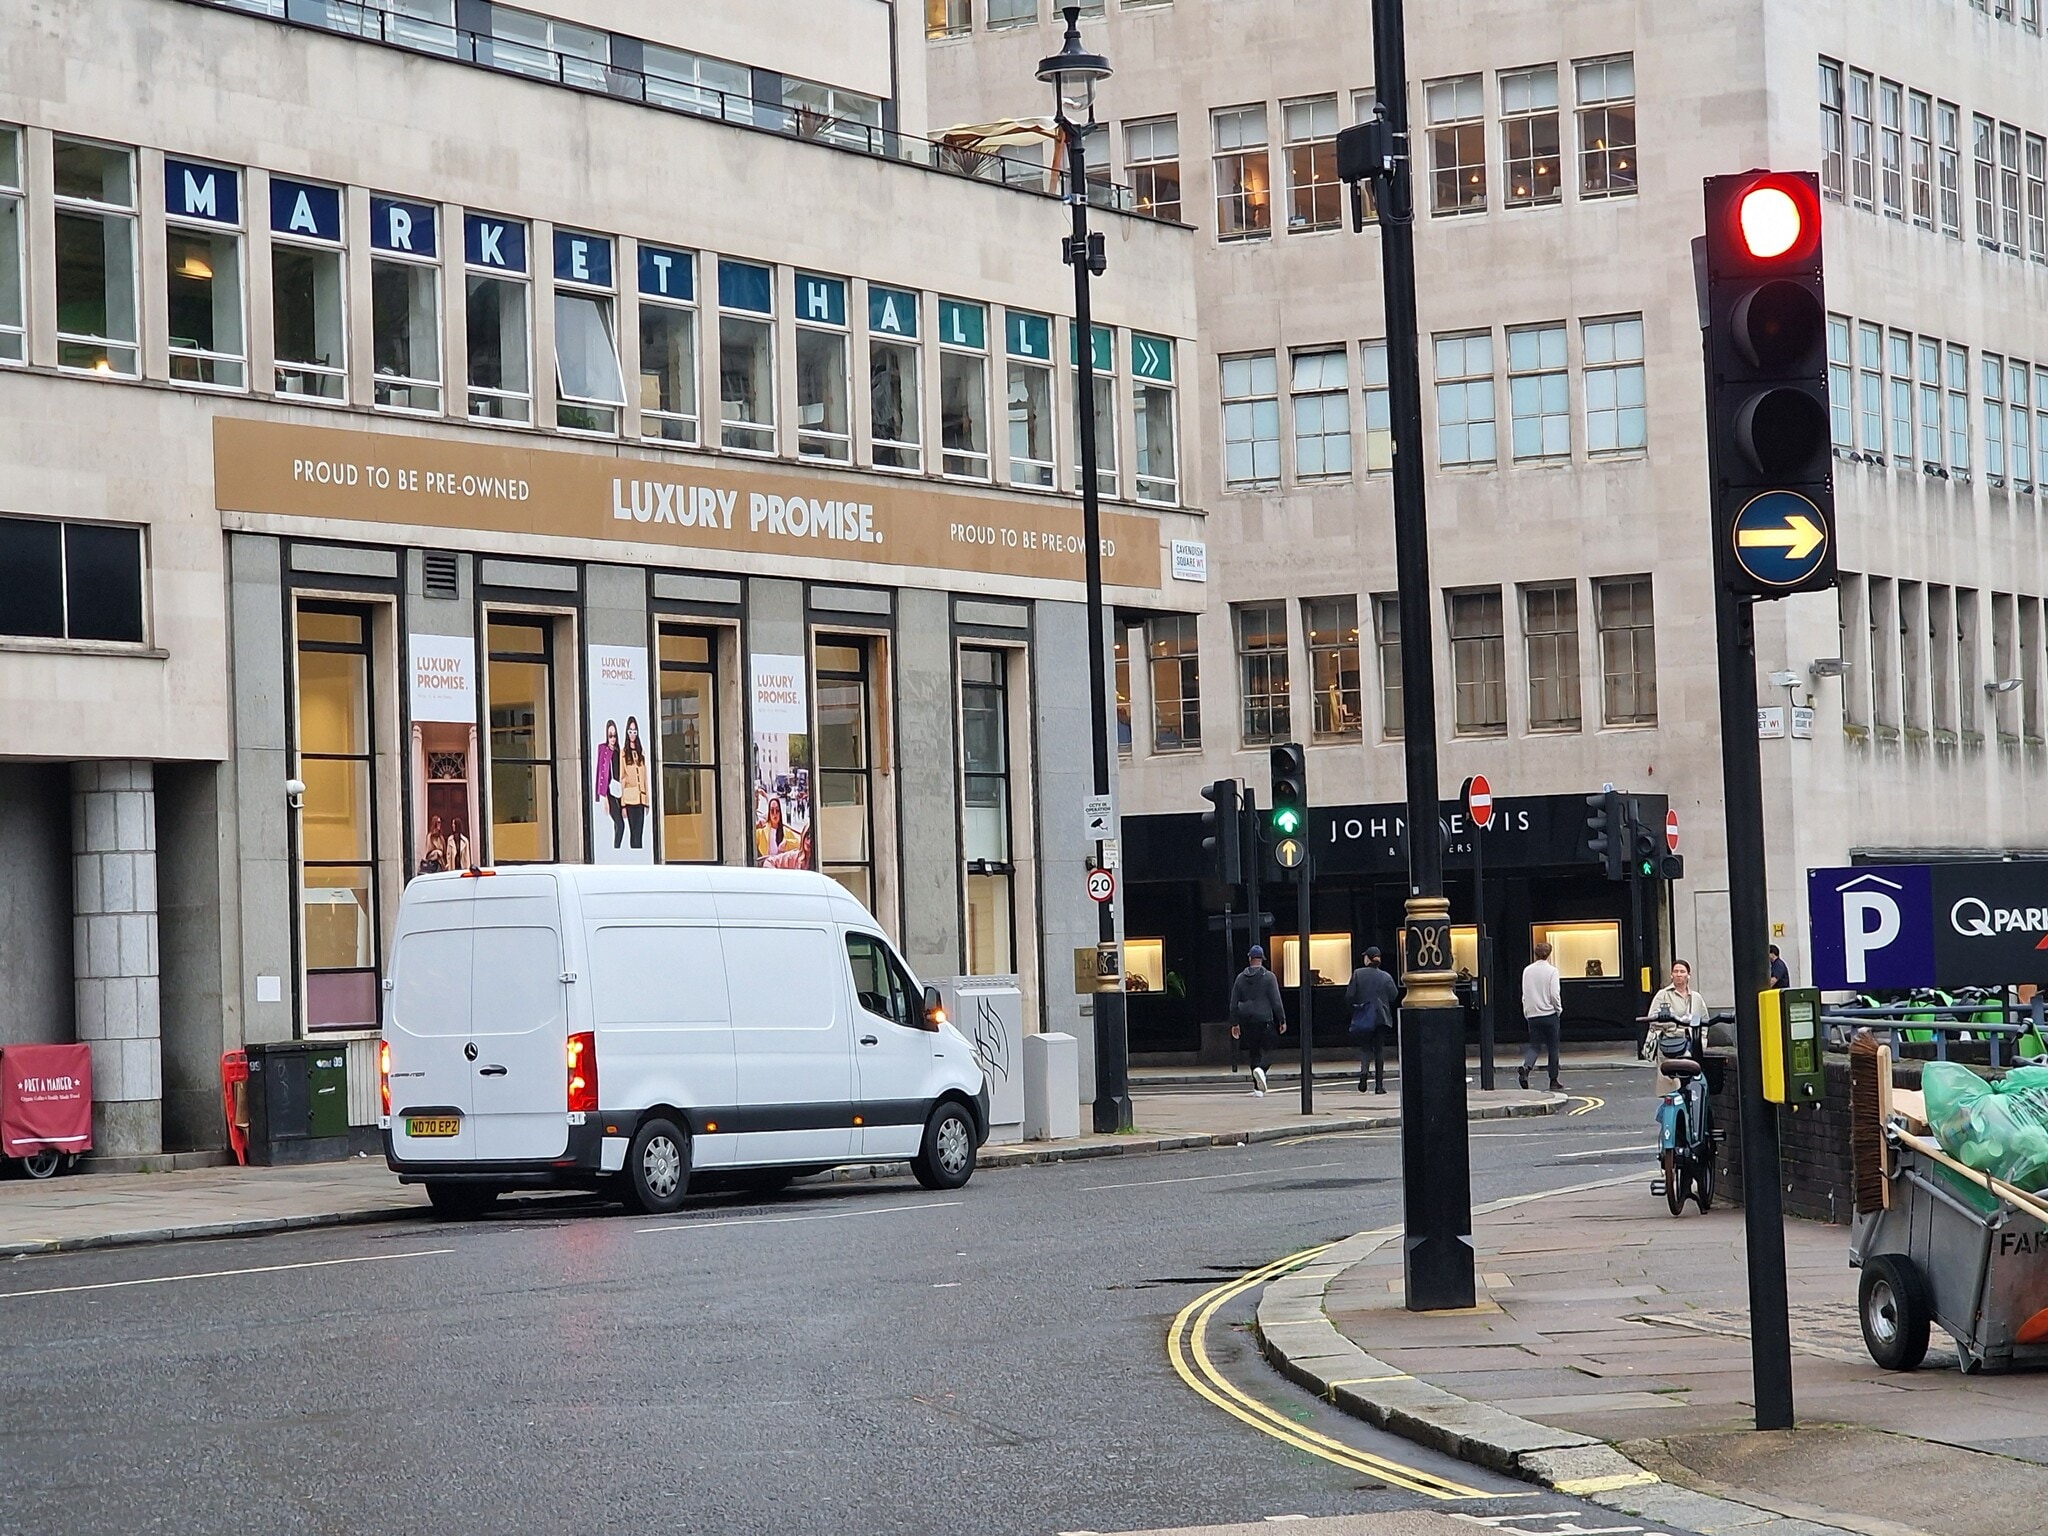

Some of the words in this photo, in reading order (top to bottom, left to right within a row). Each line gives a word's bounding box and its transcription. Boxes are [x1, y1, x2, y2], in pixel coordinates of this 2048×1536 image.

[183, 168, 673, 294] MARKET
[293, 459, 358, 486] PROUD
[366, 466, 390, 489] TO
[398, 469, 418, 491] BE
[426, 472, 530, 501] PRE-OWNED
[612, 478, 738, 529] LUXURY
[750, 493, 884, 544] PROMISE.
[950, 523, 996, 545] PROUD
[1000, 528, 1018, 547] TO
[1022, 531, 1037, 550] BE
[1042, 533, 1116, 557] PRE-OWED
[1176, 544, 1203, 556] CAVENDISH
[1176, 556, 1196, 568] SQUARE
[417, 656, 461, 673] LUXURY
[601, 657, 631, 669] LUXURY
[417, 674, 469, 691] PROMISE.
[602, 669, 636, 681] PROMISE.
[757, 674, 794, 689] LUXURY
[757, 690, 801, 705] PROMISE.
[1091, 878, 1111, 892] 20
[1842, 891, 1901, 984] P
[24, 1077, 40, 1093] PRET
[41, 1078, 47, 1092] A
[47, 1075, 73, 1092] MANGER
[412, 1120, 437, 1133] ND70
[438, 1120, 458, 1133] EPZ
